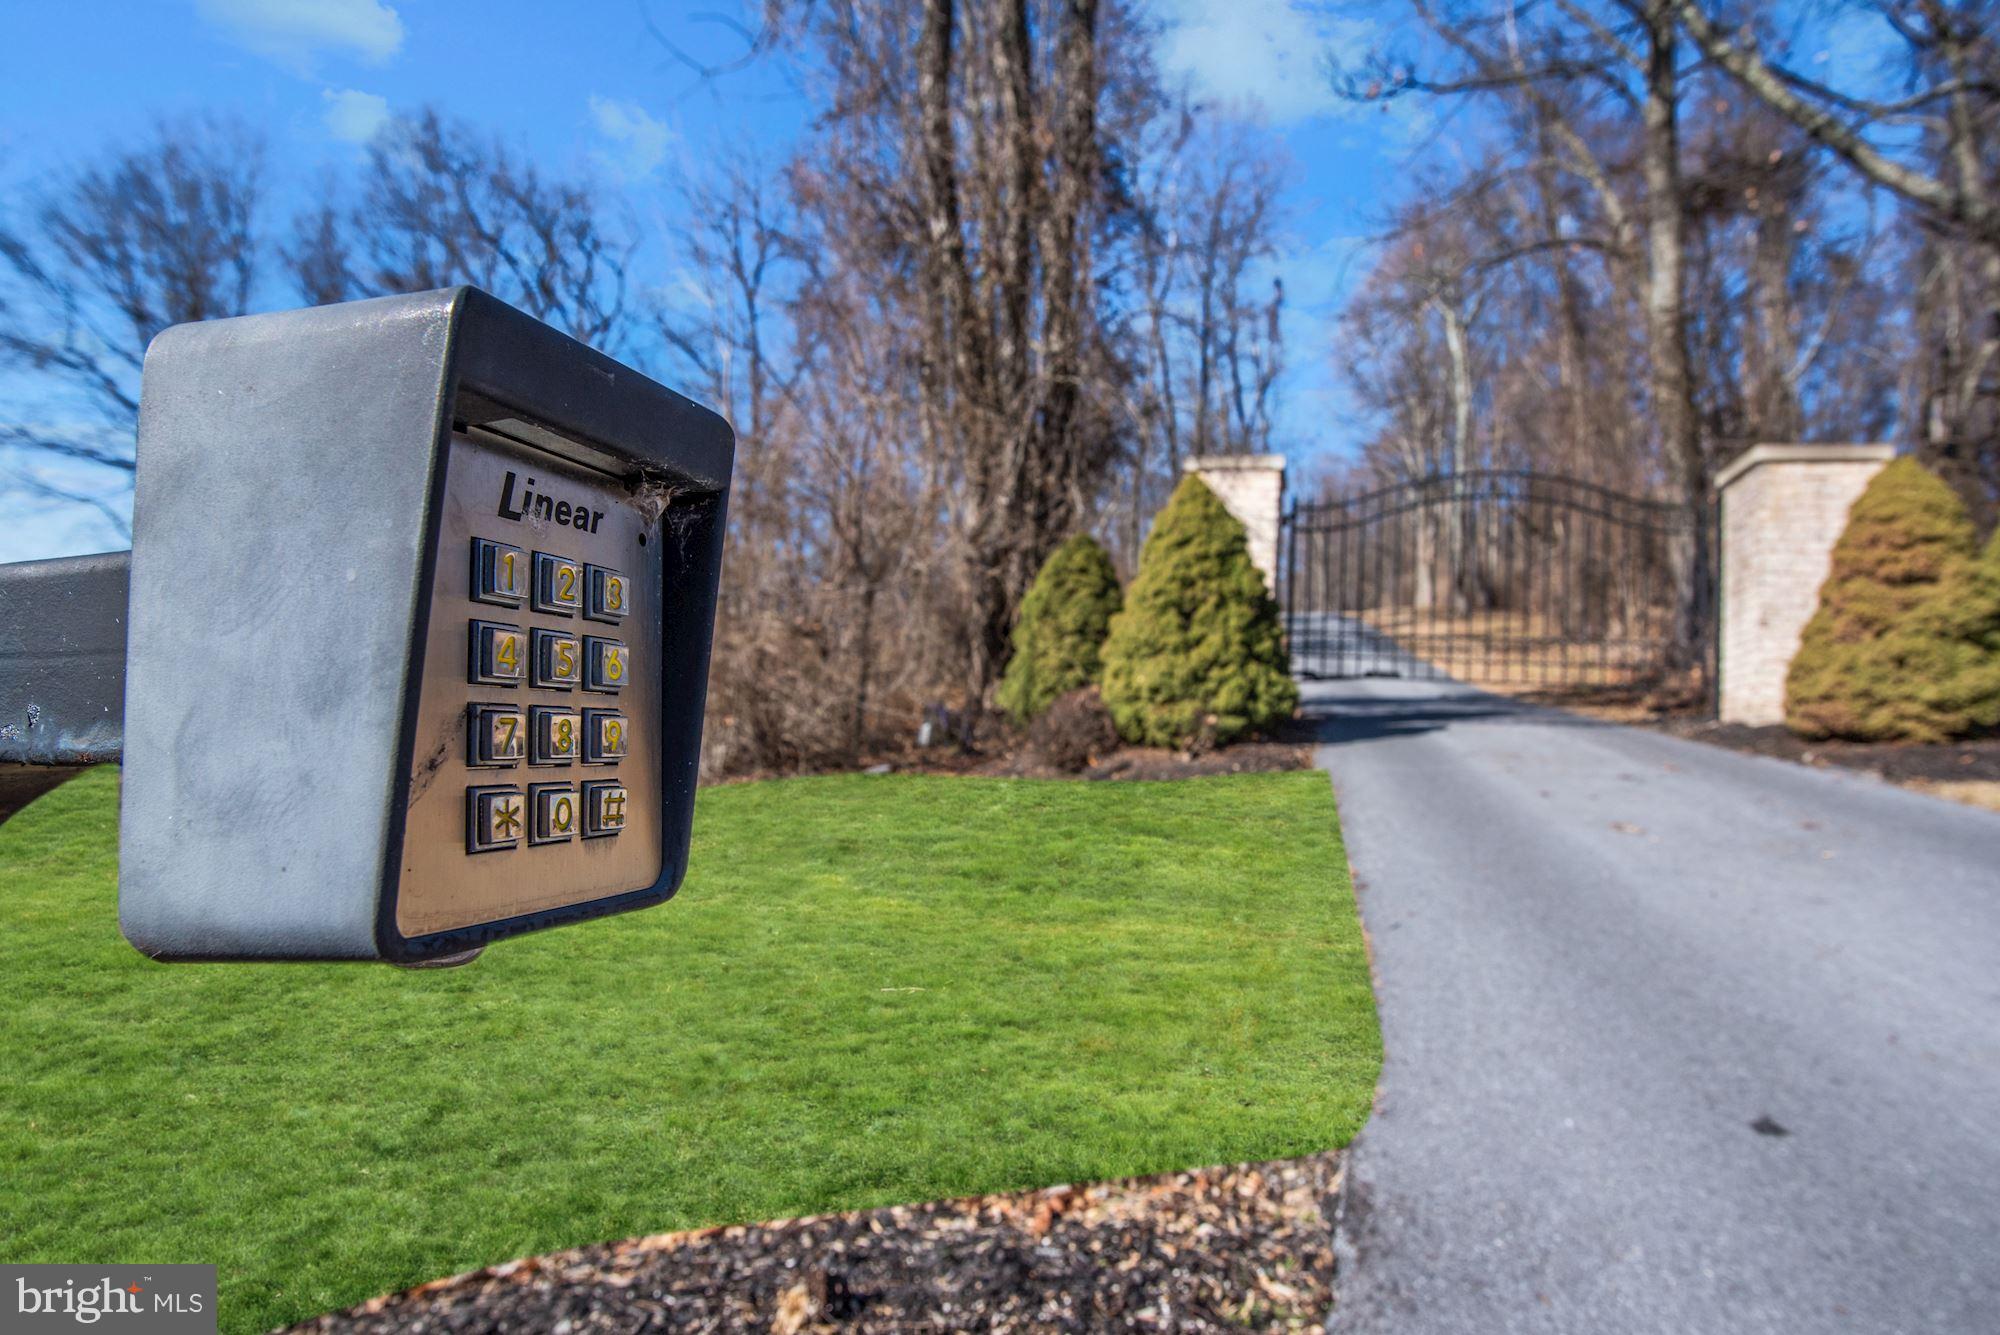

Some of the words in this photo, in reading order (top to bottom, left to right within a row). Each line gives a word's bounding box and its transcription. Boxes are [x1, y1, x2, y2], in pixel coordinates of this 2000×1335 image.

[498, 471, 604, 534] Linear
[503, 553, 516, 591] 1
[559, 567, 575, 601] 2
[609, 578, 622, 609] 3
[497, 636, 517, 672] 4
[557, 642, 574, 676] 5
[607, 649, 622, 680] 6
[500, 717, 518, 754] 7
[558, 719, 572, 752] 8
[607, 721, 621, 751] 9
[555, 797, 573, 832] 0
